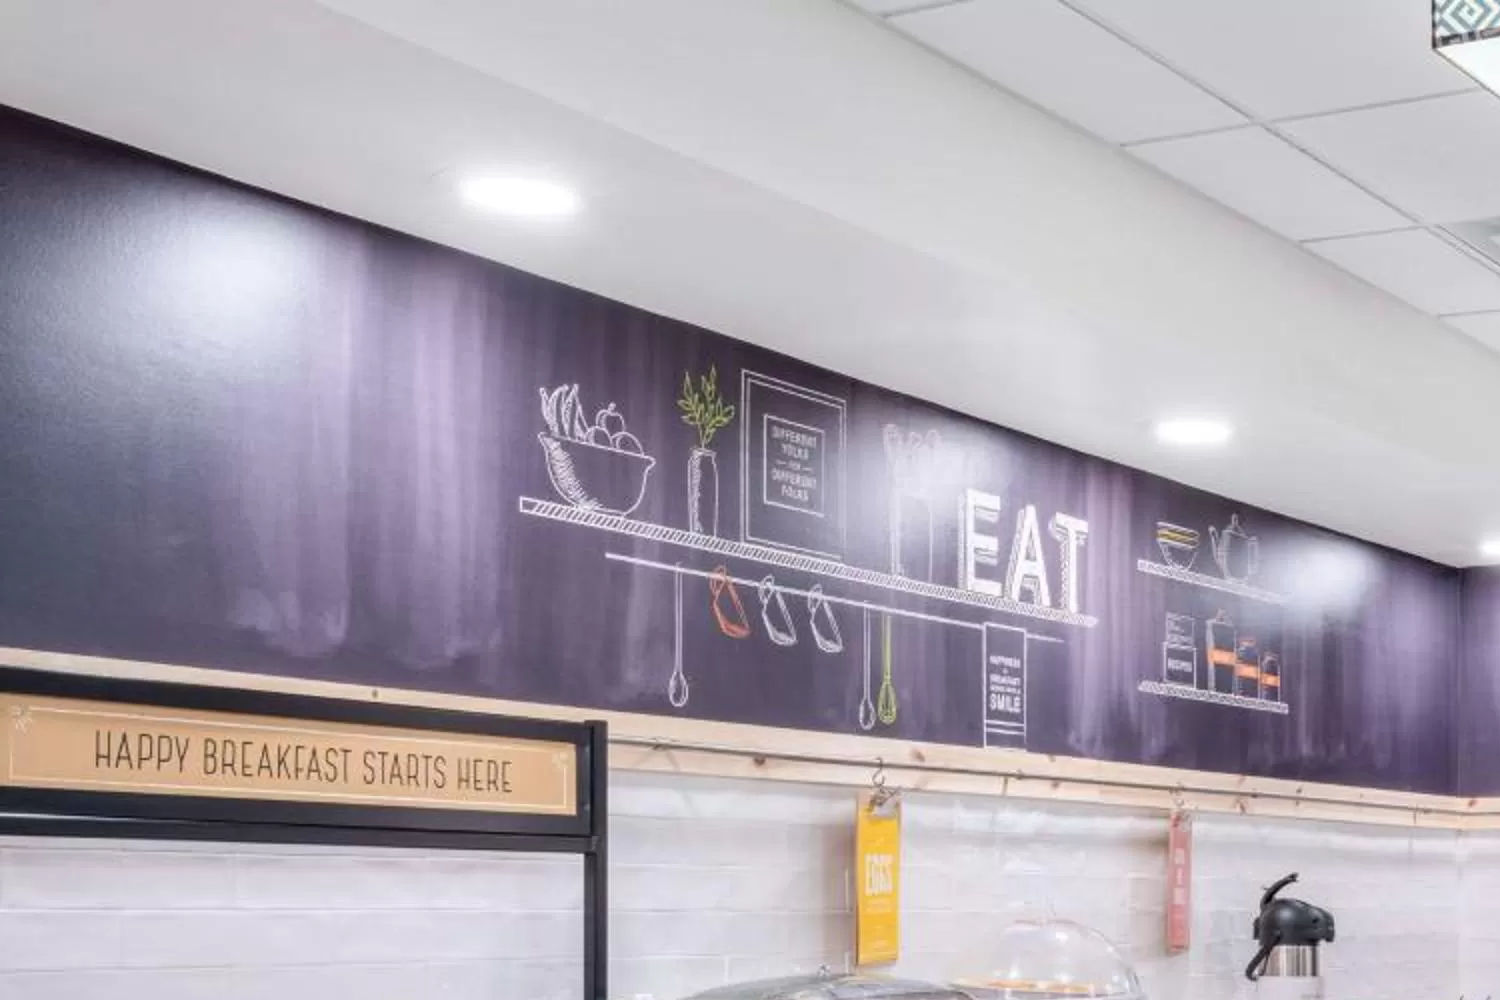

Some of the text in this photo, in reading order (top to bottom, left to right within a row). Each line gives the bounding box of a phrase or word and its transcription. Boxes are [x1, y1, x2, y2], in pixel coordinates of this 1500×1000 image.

[957, 488, 1089, 614] EAT
[989, 693, 1021, 712] SMILE
[95, 730, 513, 793] HAPPY BREAKFAST STARTS HERE
